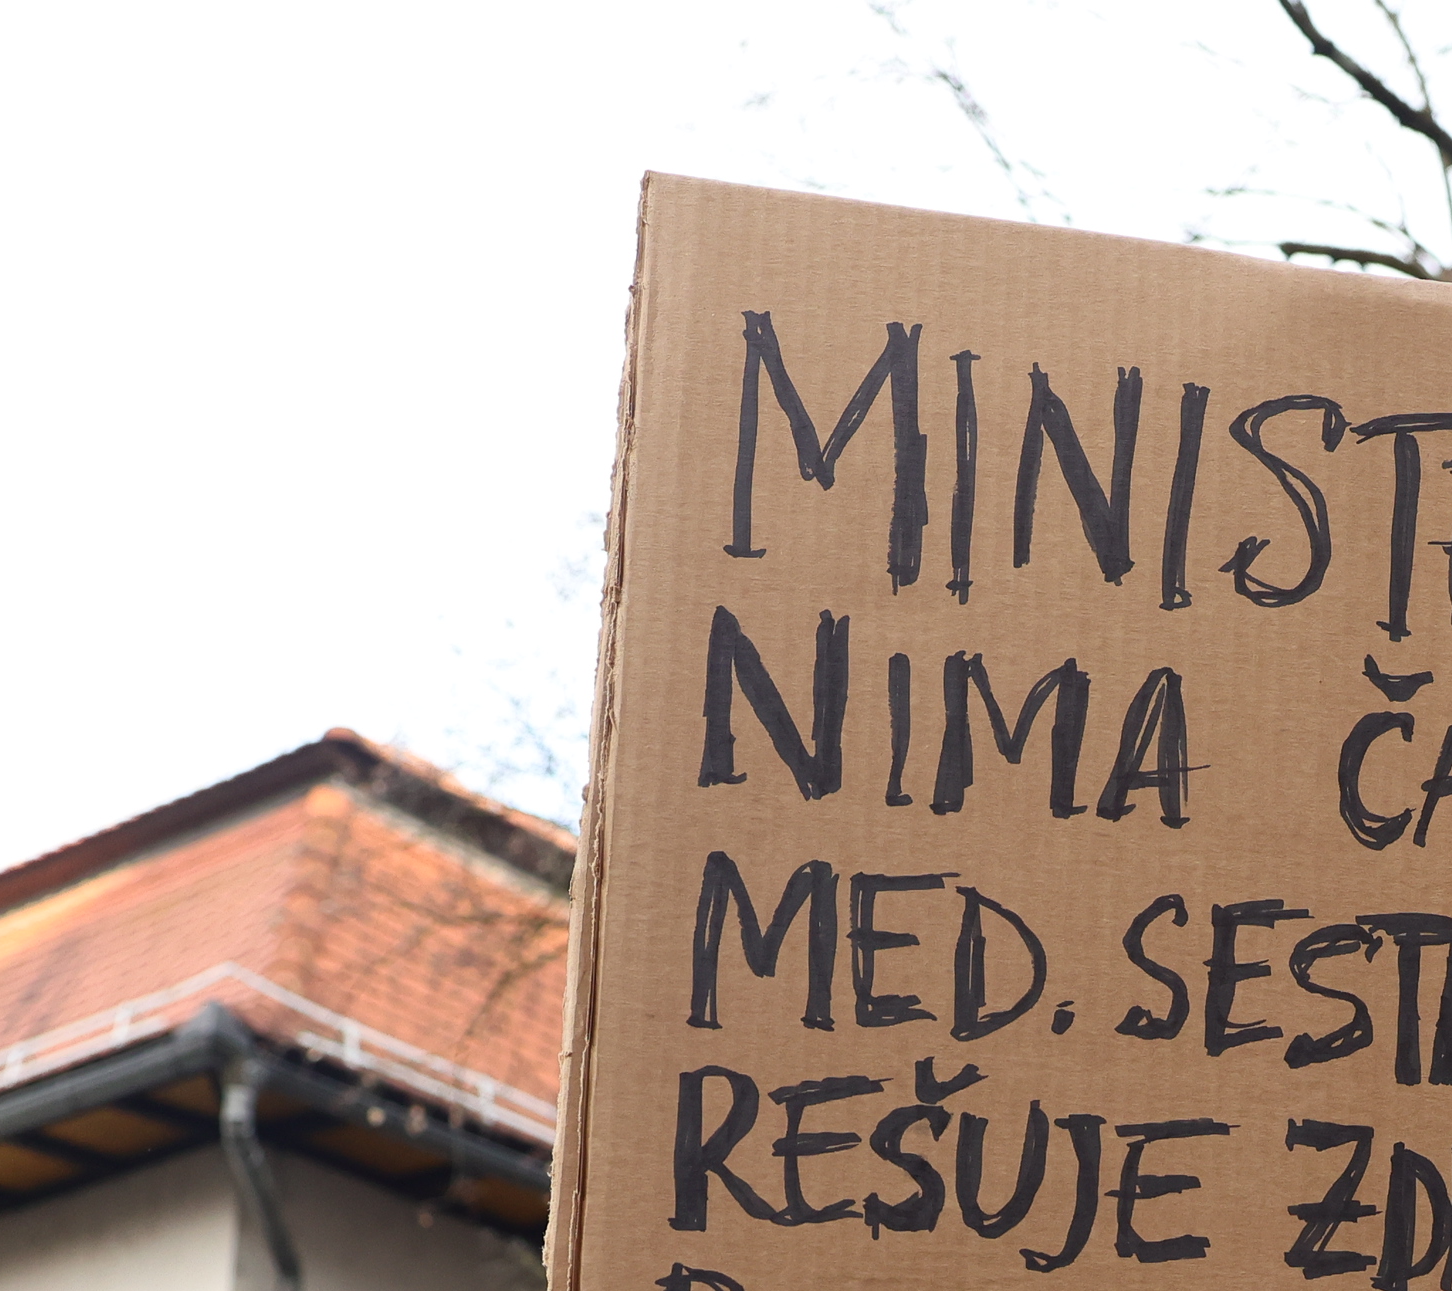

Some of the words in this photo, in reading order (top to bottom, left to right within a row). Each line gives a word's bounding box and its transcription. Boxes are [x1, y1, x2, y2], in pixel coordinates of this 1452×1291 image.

[697, 606, 1211, 826] NIMA
[687, 851, 1073, 1041] MED.
[671, 1057, 1239, 1272] REŠUJE
